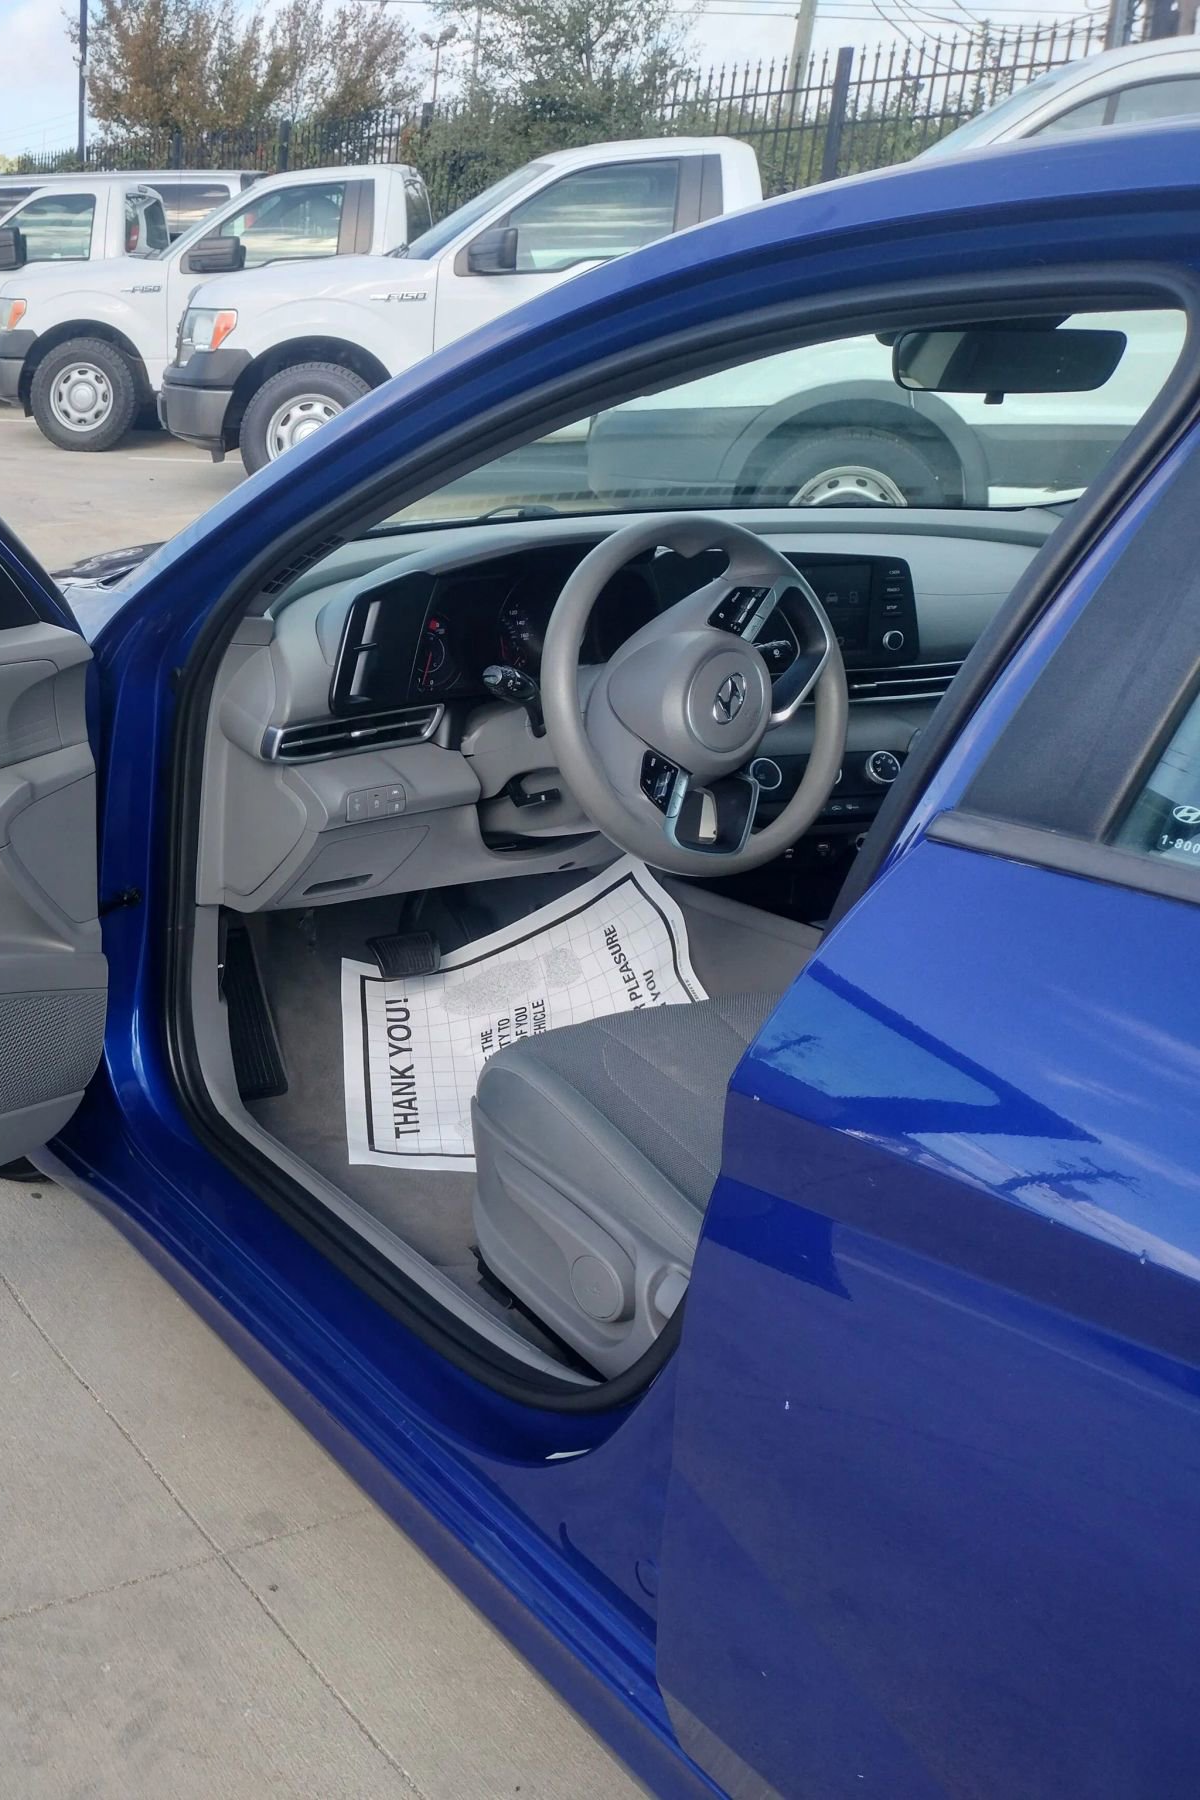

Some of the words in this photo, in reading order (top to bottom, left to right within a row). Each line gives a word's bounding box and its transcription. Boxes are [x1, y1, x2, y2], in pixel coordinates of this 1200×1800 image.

[603, 924, 643, 1002] PLEASURE
[643, 969, 661, 1002] YOU
[385, 997, 413, 1058] YOU!
[497, 1018, 510, 1033] TO
[514, 1006, 528, 1028] YOU
[481, 1028, 493, 1053] THE
[389, 1063, 421, 1139] THANK
